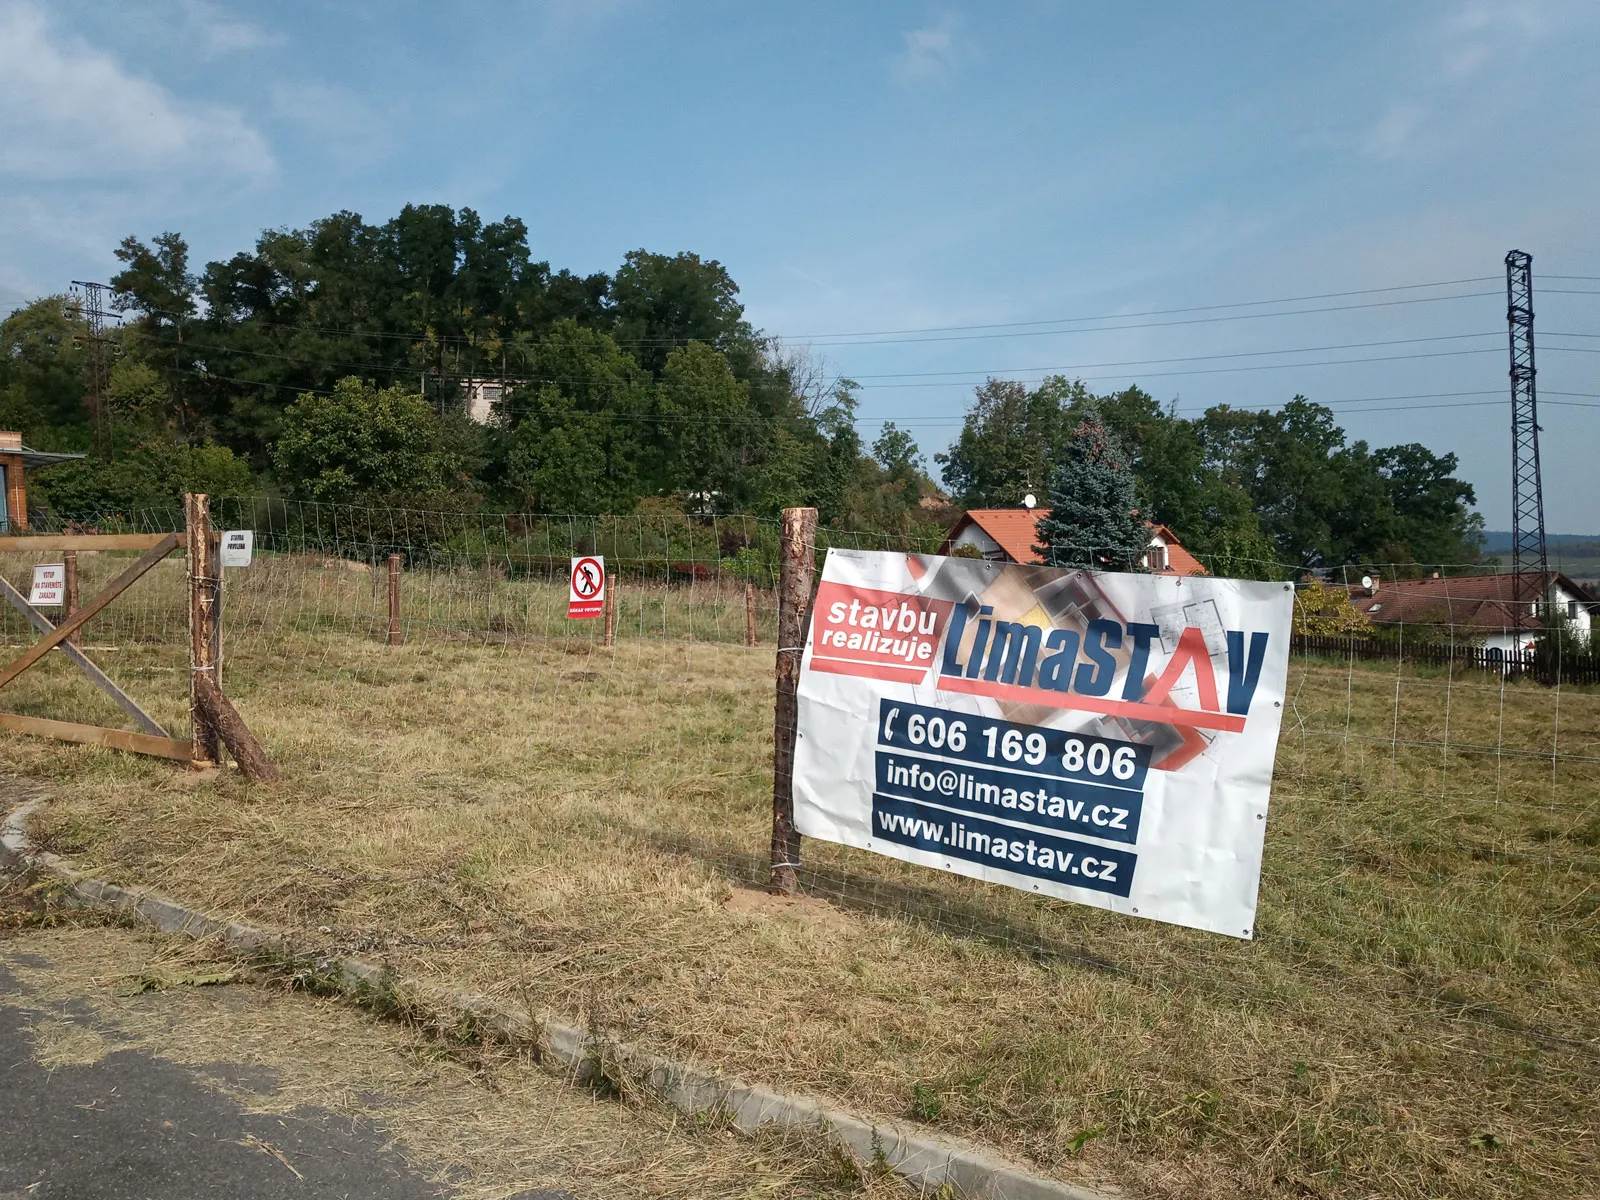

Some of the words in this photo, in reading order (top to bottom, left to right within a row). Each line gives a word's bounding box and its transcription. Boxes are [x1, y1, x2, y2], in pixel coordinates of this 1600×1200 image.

[821, 629, 933, 662] realizuje
[827, 598, 938, 636] stavbu
[907, 714, 968, 752] 606
[982, 726, 1047, 766] 169
[1061, 738, 1137, 781] 806
[887, 759, 1130, 830] info@limastav.cz
[878, 810, 1118, 883] www.limastav.cz
